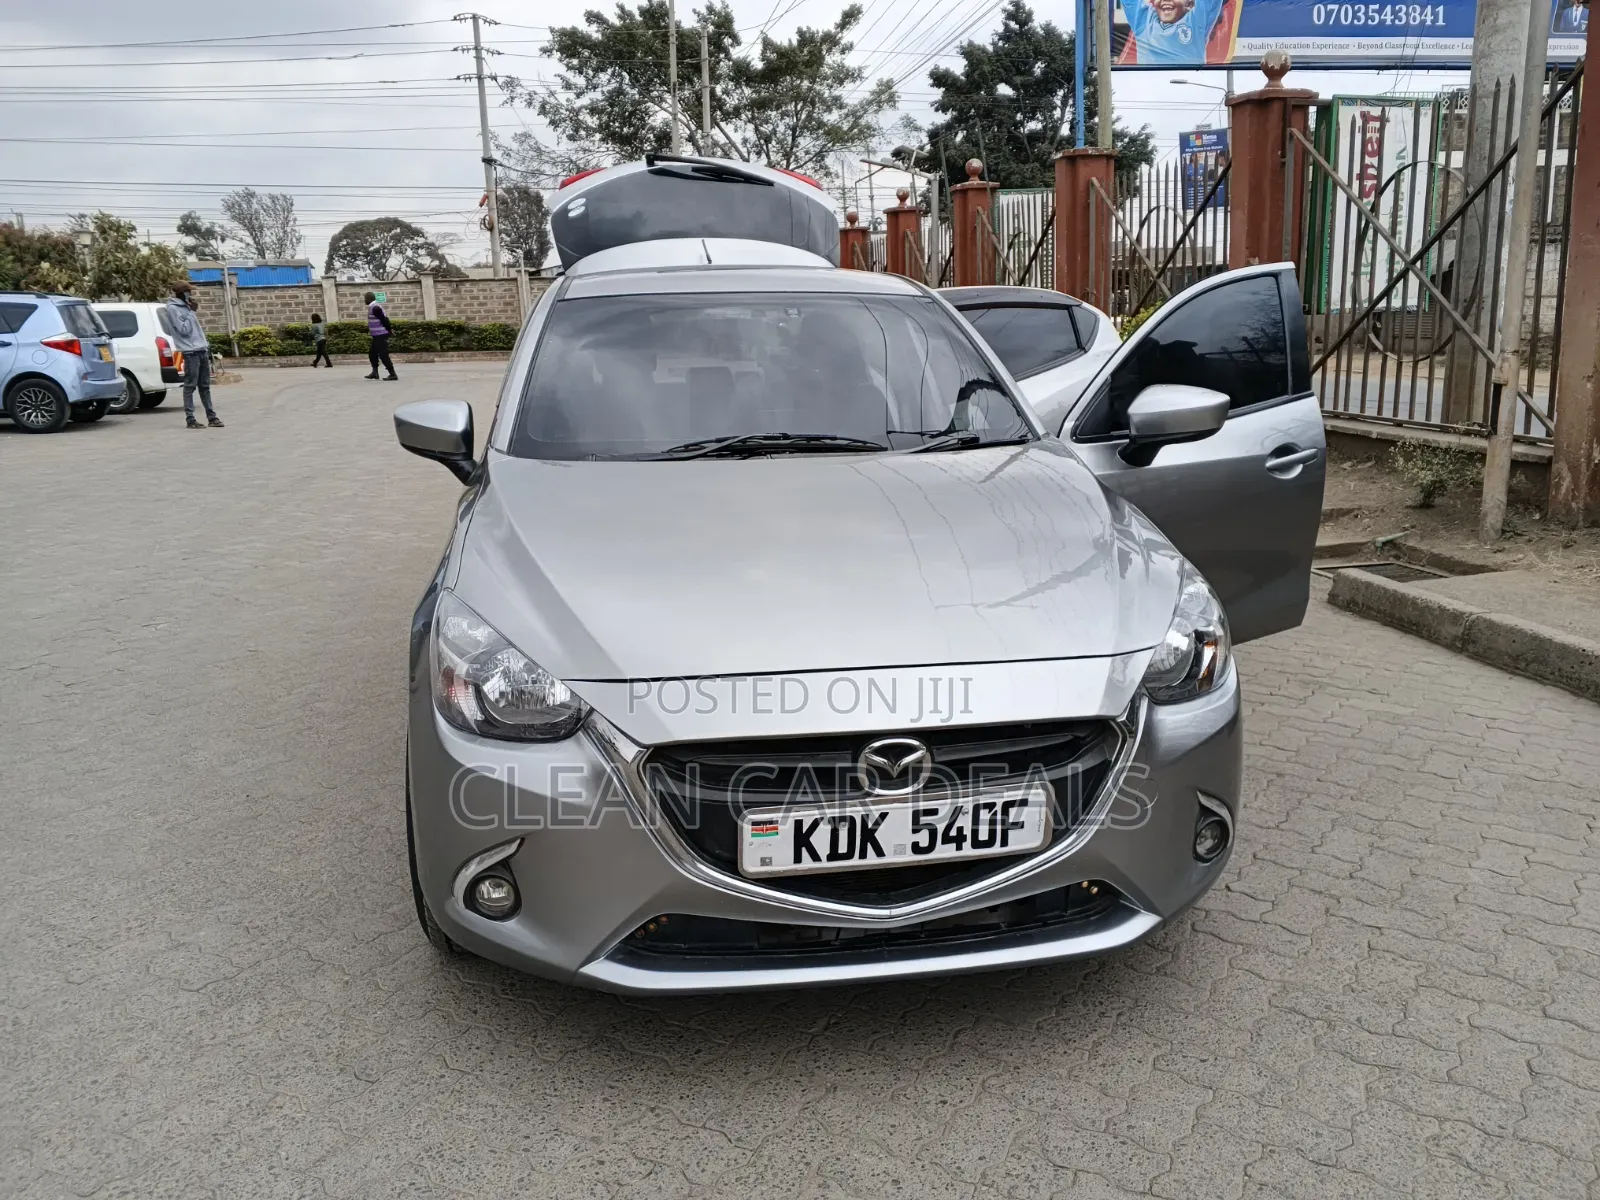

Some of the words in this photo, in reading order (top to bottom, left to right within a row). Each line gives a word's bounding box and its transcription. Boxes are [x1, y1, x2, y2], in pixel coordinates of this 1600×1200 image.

[1312, 3, 1447, 26] 0703543841
[1247, 42, 1273, 51] Quality
[1275, 42, 1311, 50] Education
[1312, 42, 1350, 51] Experience
[1357, 42, 1384, 51] Beyond
[1384, 41, 1419, 50] Classroom
[1421, 42, 1456, 50] Excellence
[1547, 42, 1580, 51] xpression
[793, 811, 890, 865] KDK
[910, 798, 1029, 855] 540F
